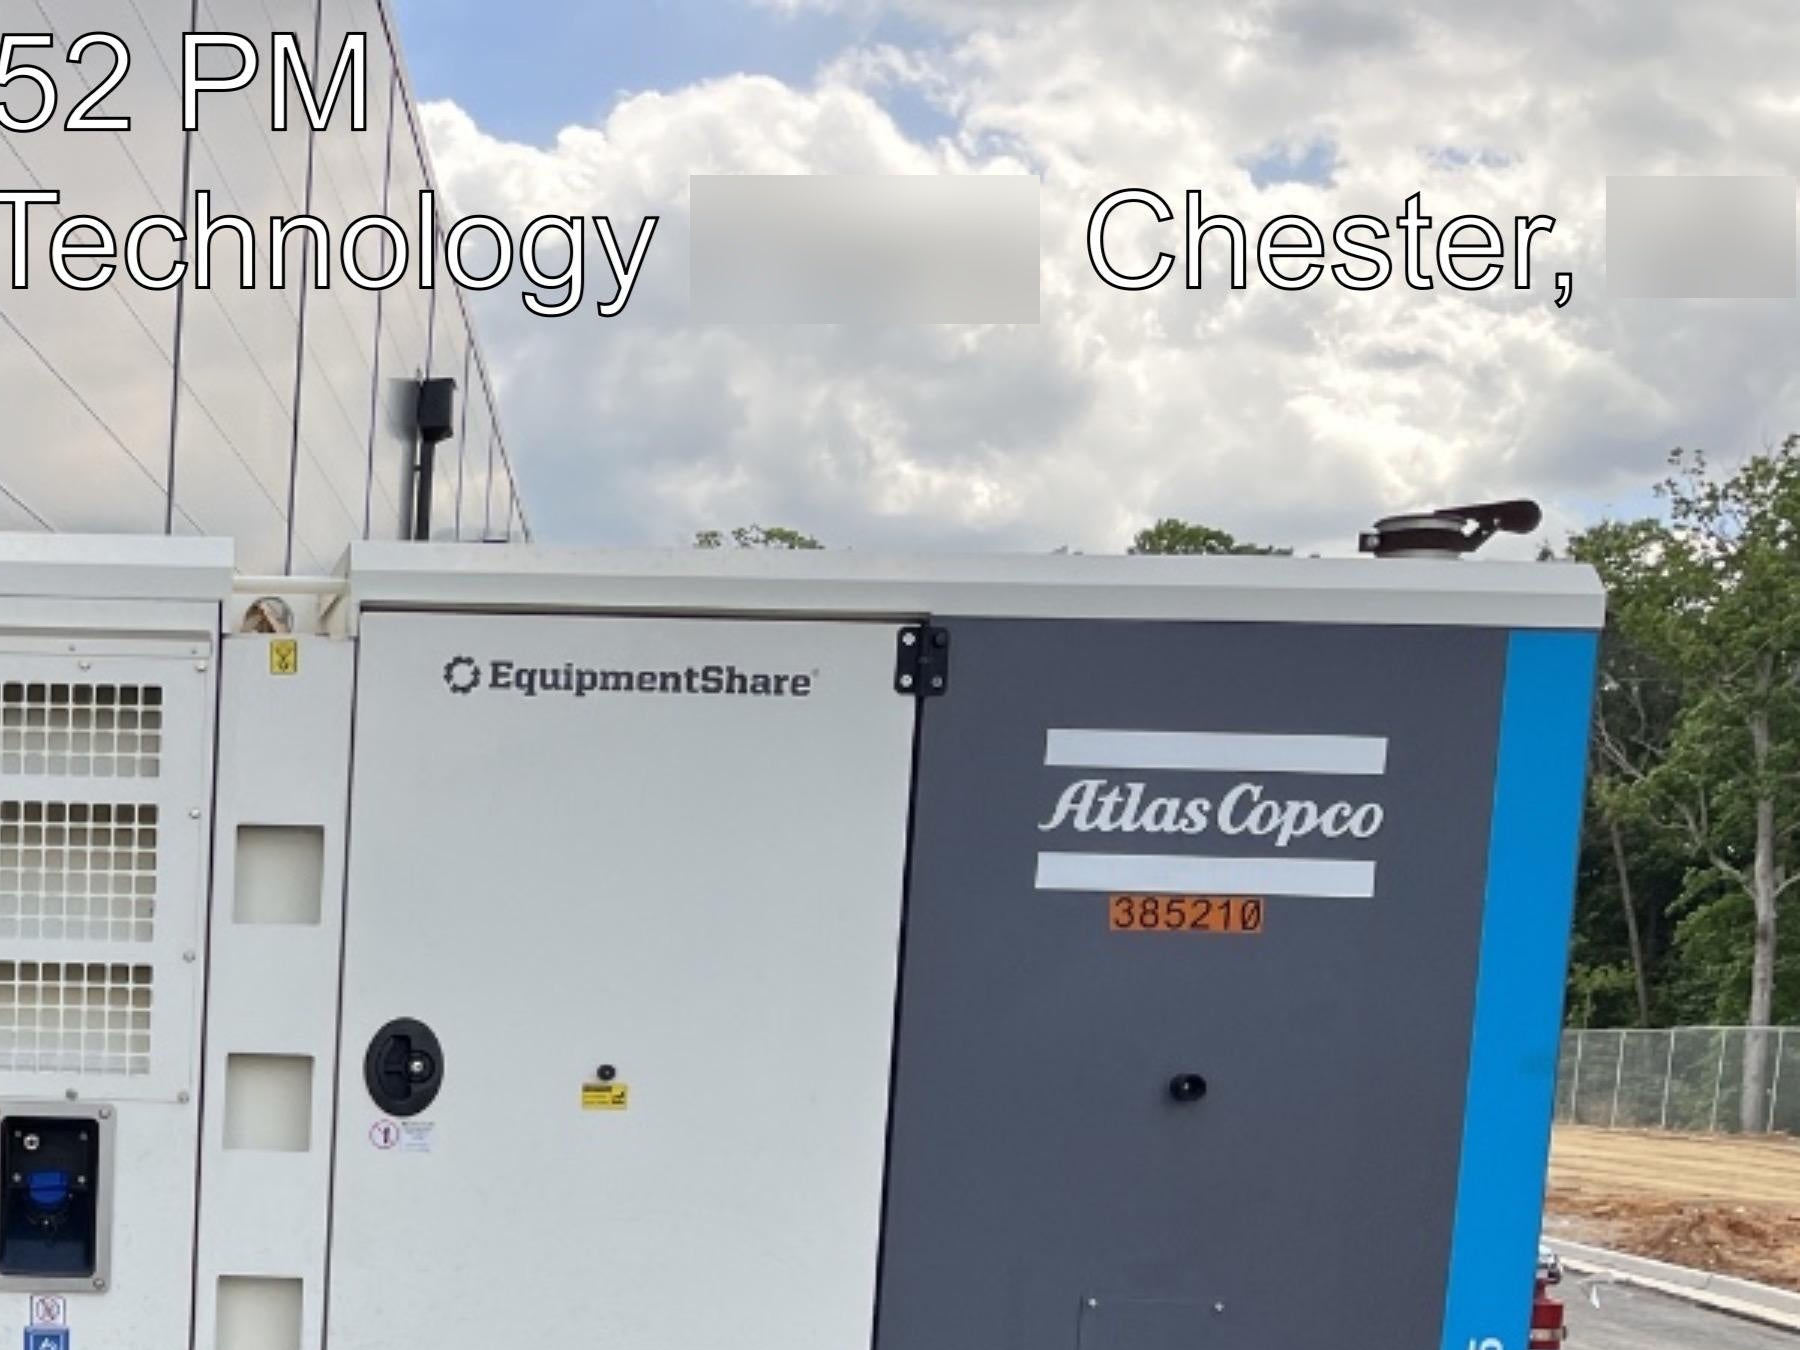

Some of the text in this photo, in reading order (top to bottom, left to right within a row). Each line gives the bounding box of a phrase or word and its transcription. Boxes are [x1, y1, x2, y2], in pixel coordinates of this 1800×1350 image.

[488, 660, 812, 698] EquipmentShare
[1037, 778, 1385, 847] Atlas Copco
[1114, 895, 1262, 932] 385210
